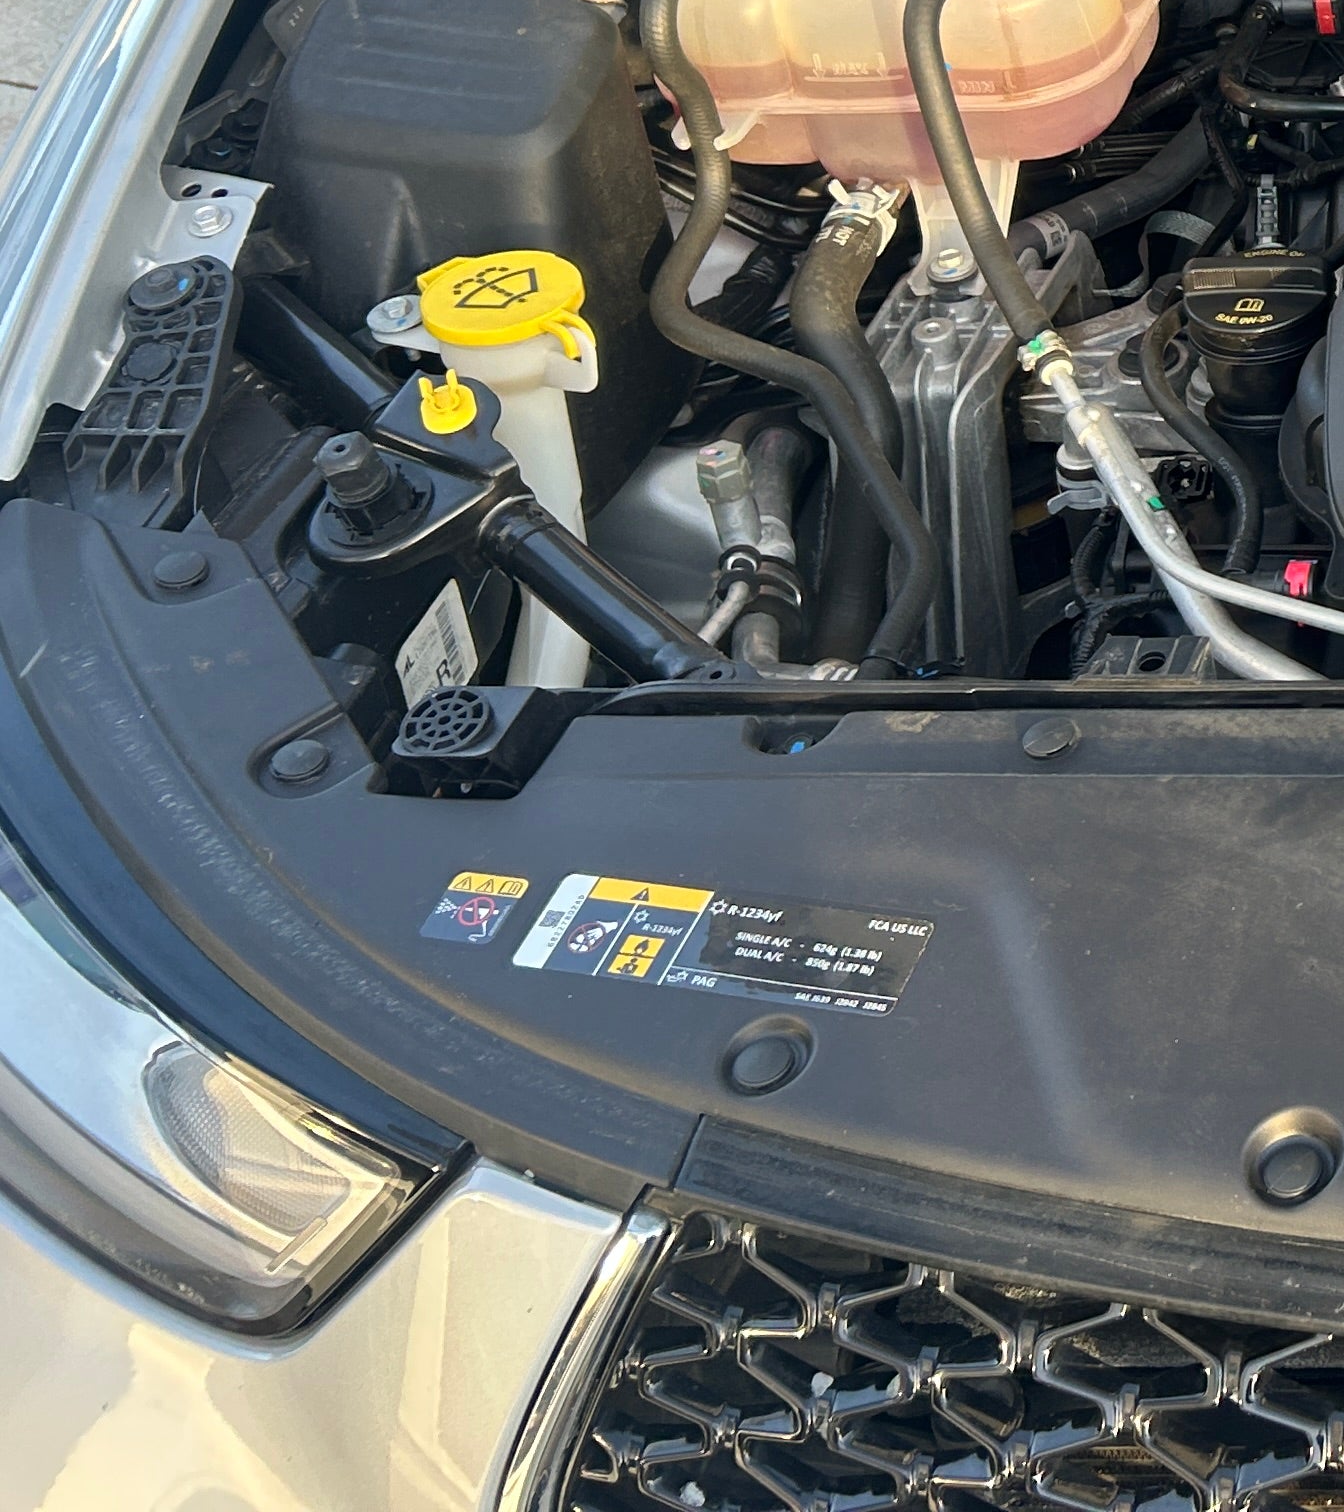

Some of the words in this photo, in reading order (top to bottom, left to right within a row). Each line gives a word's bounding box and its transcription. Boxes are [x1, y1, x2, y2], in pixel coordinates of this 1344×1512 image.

[832, 61, 869, 76] MAX
[1214, 313, 1237, 325] SAE
[1239, 313, 1274, 325] 0W-20
[726, 902, 784, 924] R-1234yf
[868, 918, 890, 933] FCA
[890, 920, 908, 934] US
[907, 923, 929, 938] LLC
[734, 930, 773, 947] SINGLE
[770, 934, 793, 950] A/C
[734, 946, 766, 961] DUAL
[763, 949, 785, 964] A/C
[690, 974, 718, 989] PAG
